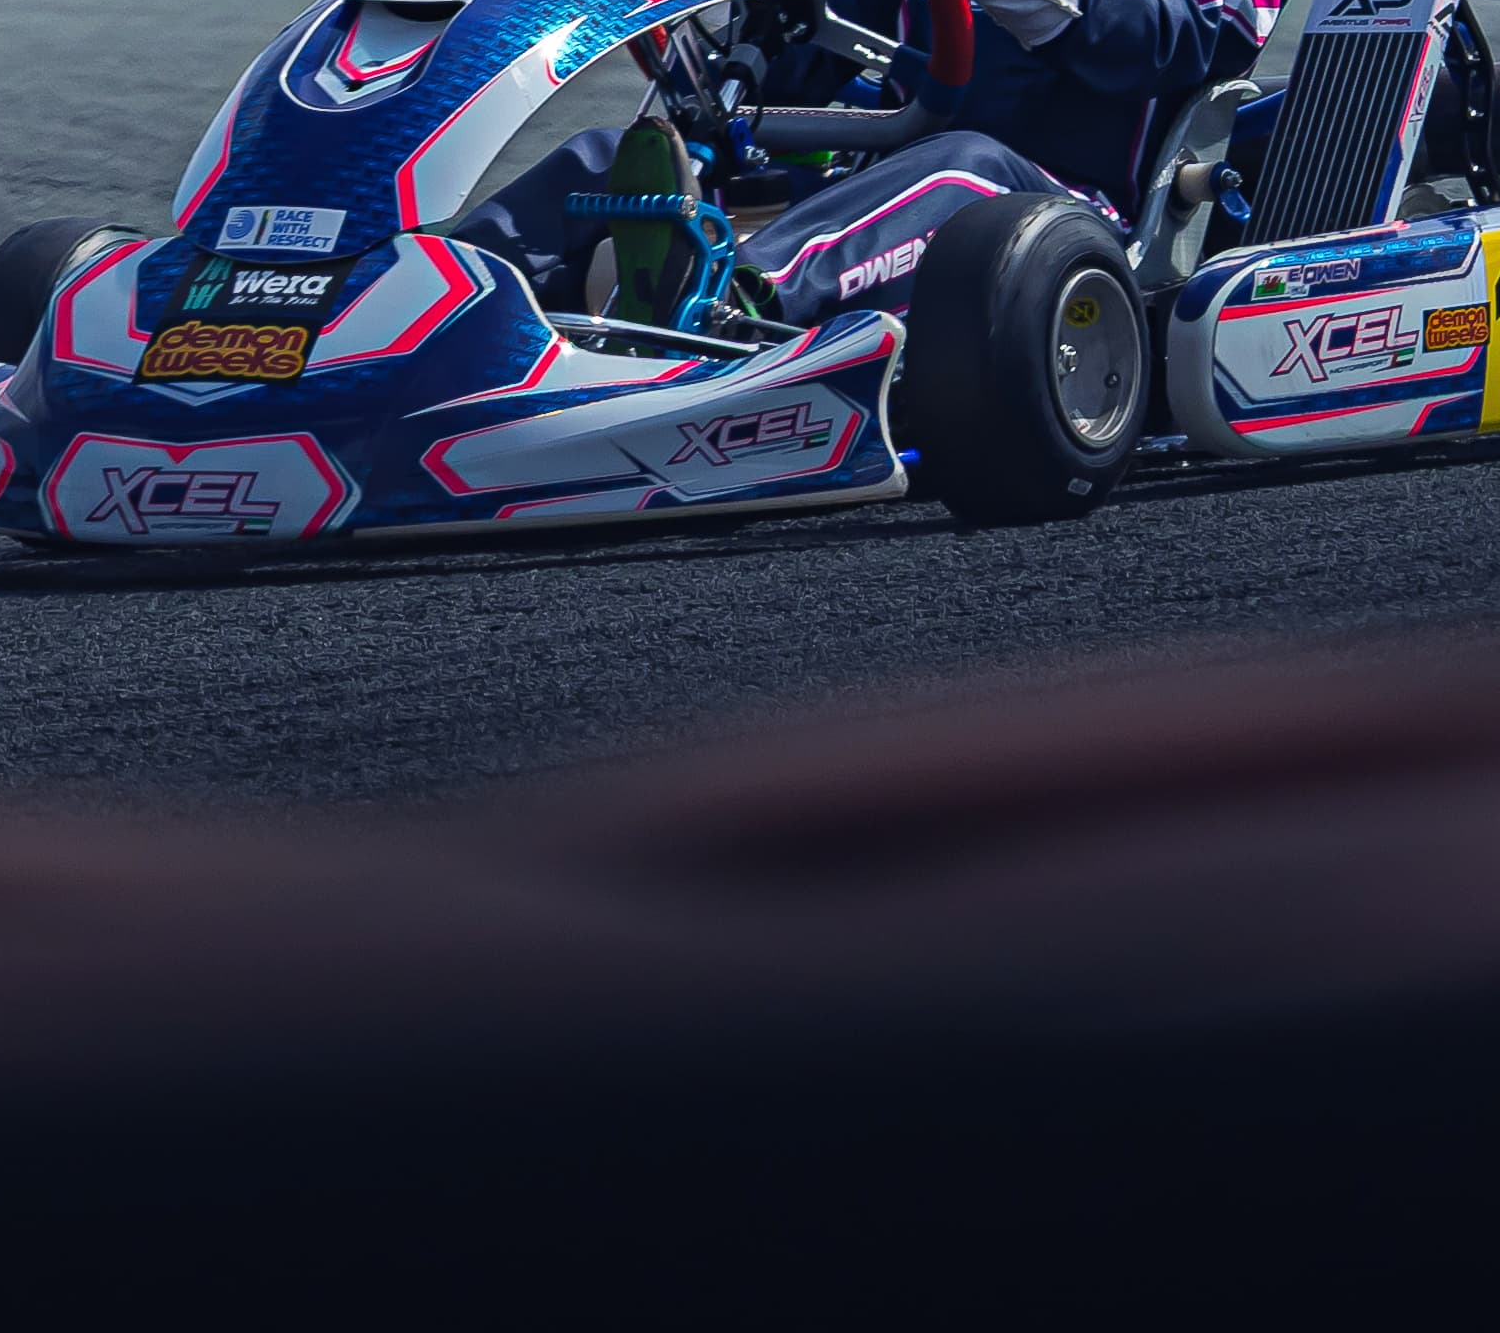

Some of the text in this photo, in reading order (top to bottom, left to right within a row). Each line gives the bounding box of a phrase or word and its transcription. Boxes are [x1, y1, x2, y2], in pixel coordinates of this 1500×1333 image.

[272, 223, 311, 234] WITH
[275, 210, 314, 222] RACE
[268, 235, 333, 248] RESPECT
[233, 270, 334, 295] Wera
[1302, 258, 1361, 285] OWEN
[1429, 307, 1488, 329] demon
[160, 322, 307, 351] demon
[1269, 304, 1420, 383] XCEL
[1426, 324, 1489, 349] tweeks
[145, 344, 303, 375] tweeks
[665, 402, 834, 467] XCEL
[85, 466, 281, 534] XCEL
